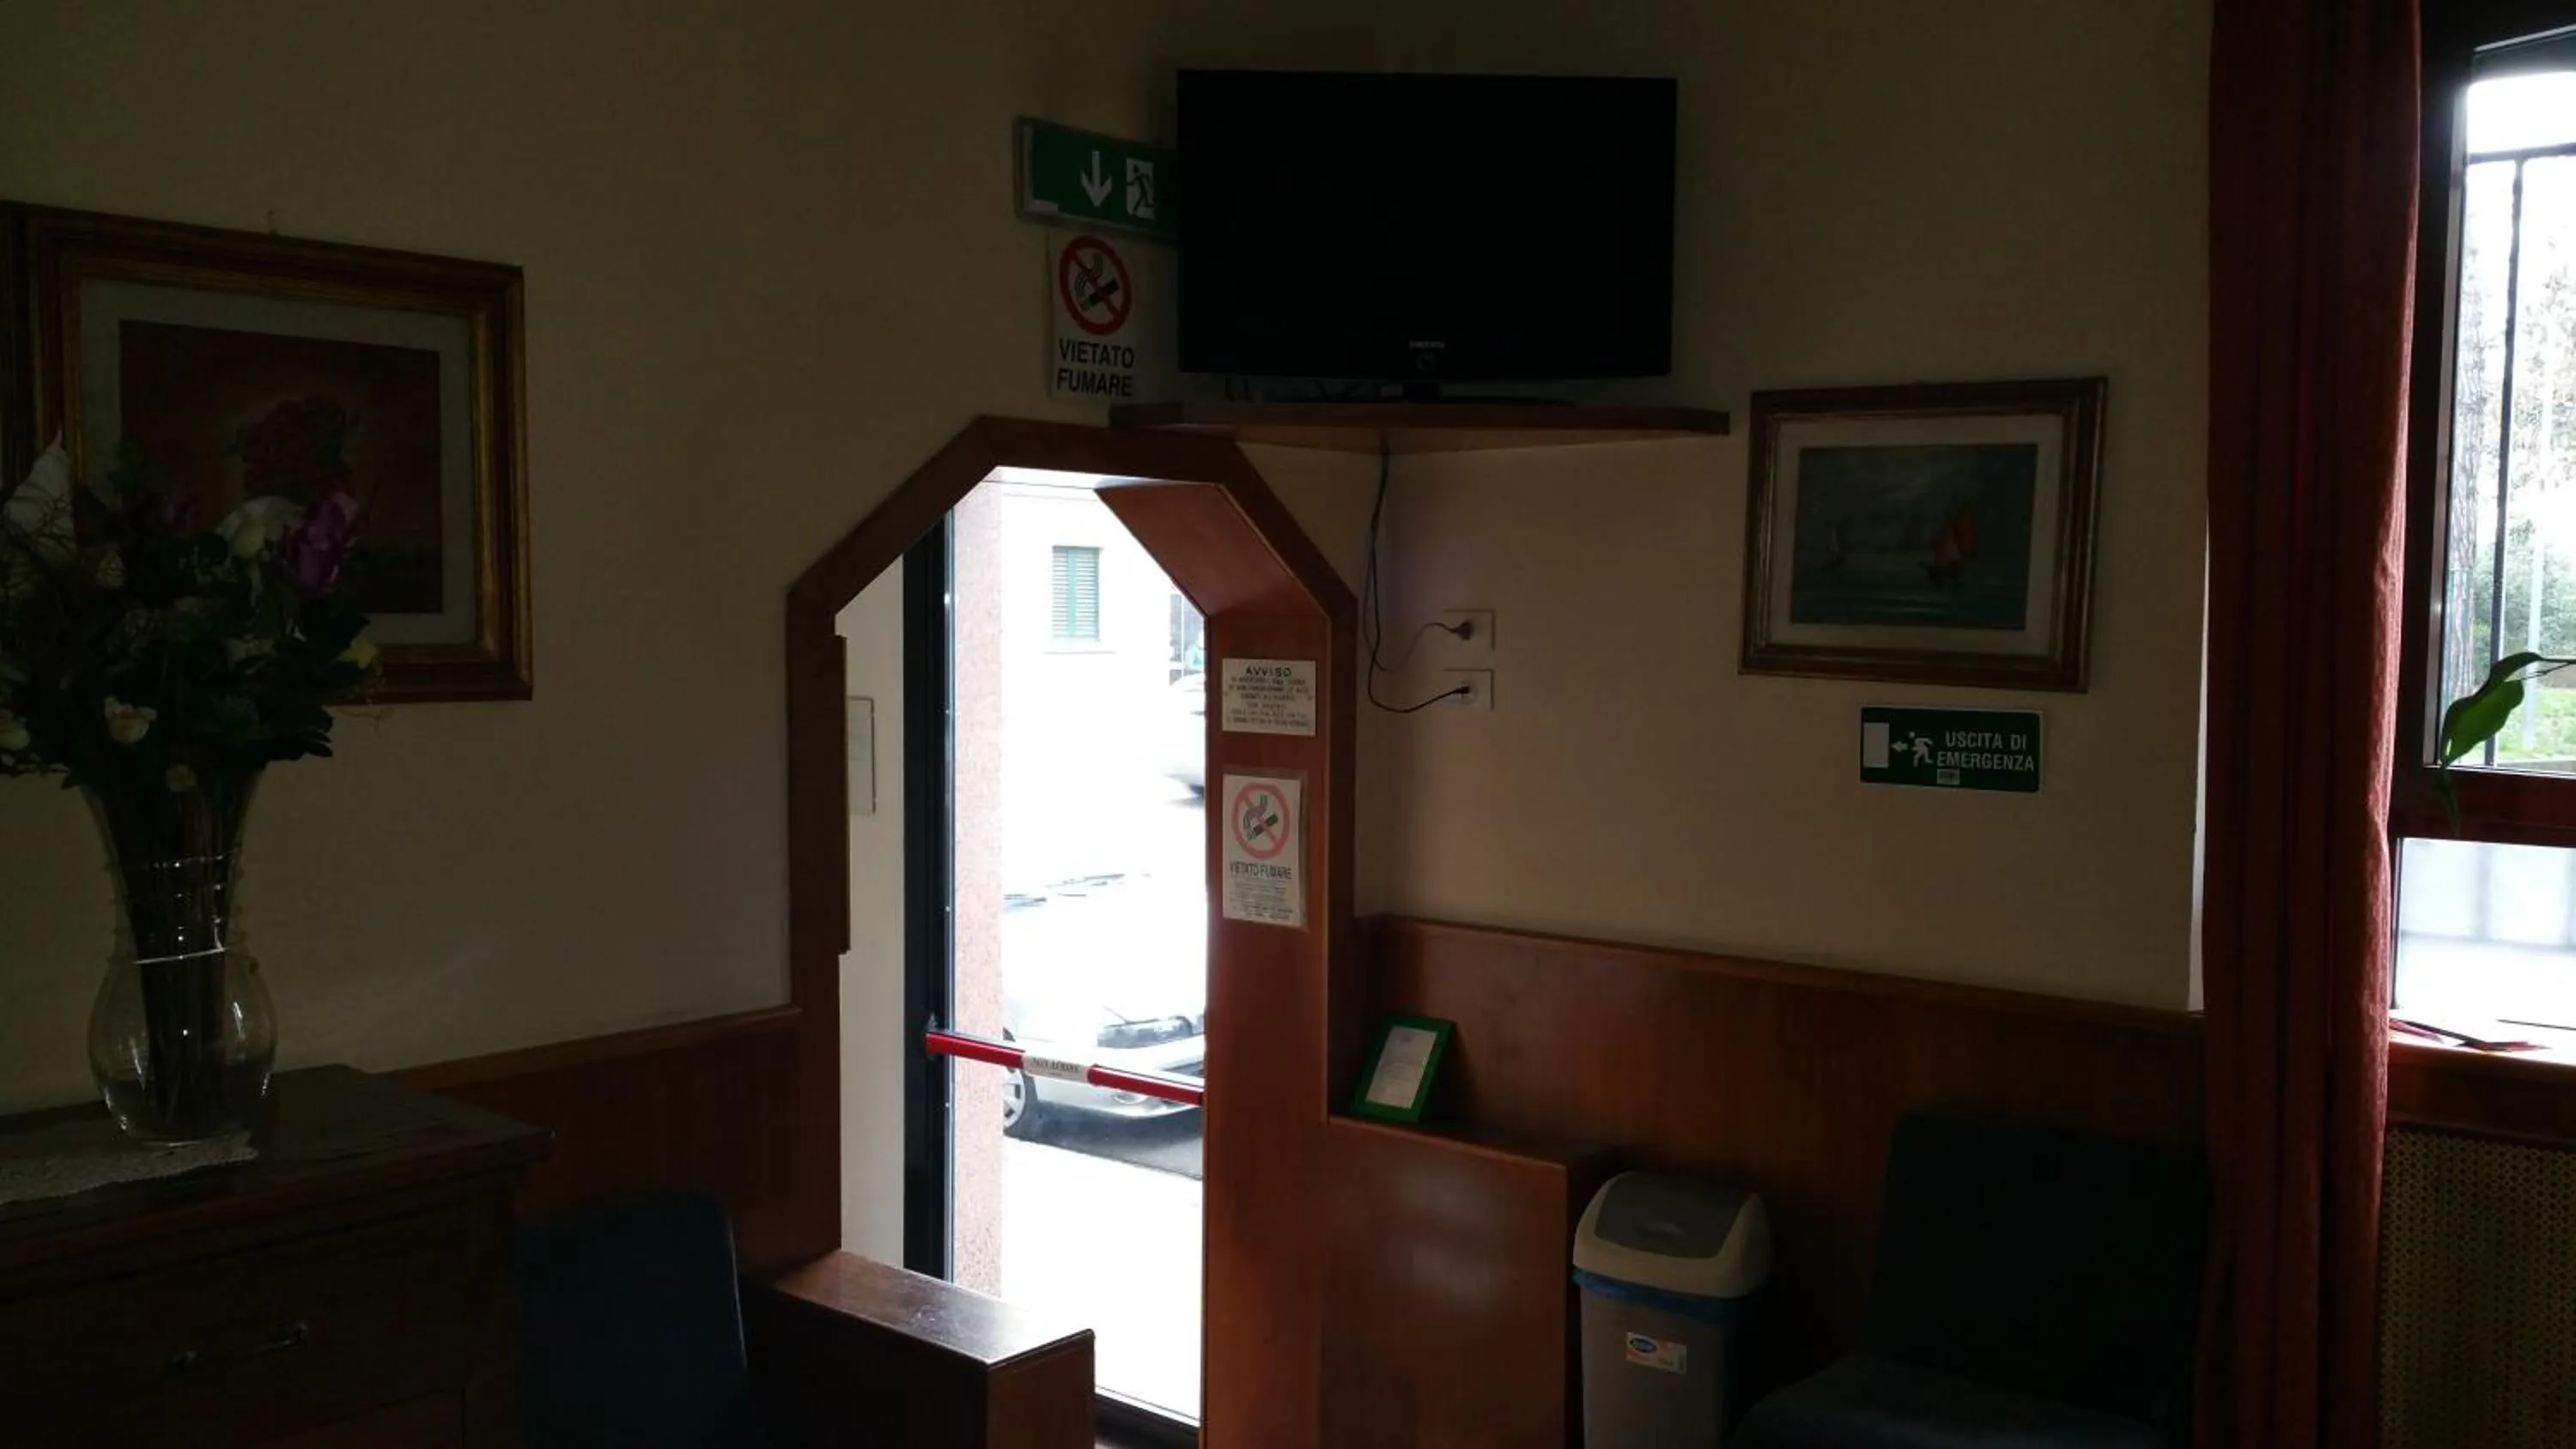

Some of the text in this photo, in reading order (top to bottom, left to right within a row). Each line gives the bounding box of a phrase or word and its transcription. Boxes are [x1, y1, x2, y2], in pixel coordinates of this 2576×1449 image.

[1059, 337, 1135, 369] VIETATO
[1057, 367, 1133, 397] FUMARE
[1245, 666, 1292, 677] AVVISO
[1945, 731, 2026, 751] USCITA DI
[1937, 751, 2034, 772] EMERGENZA
